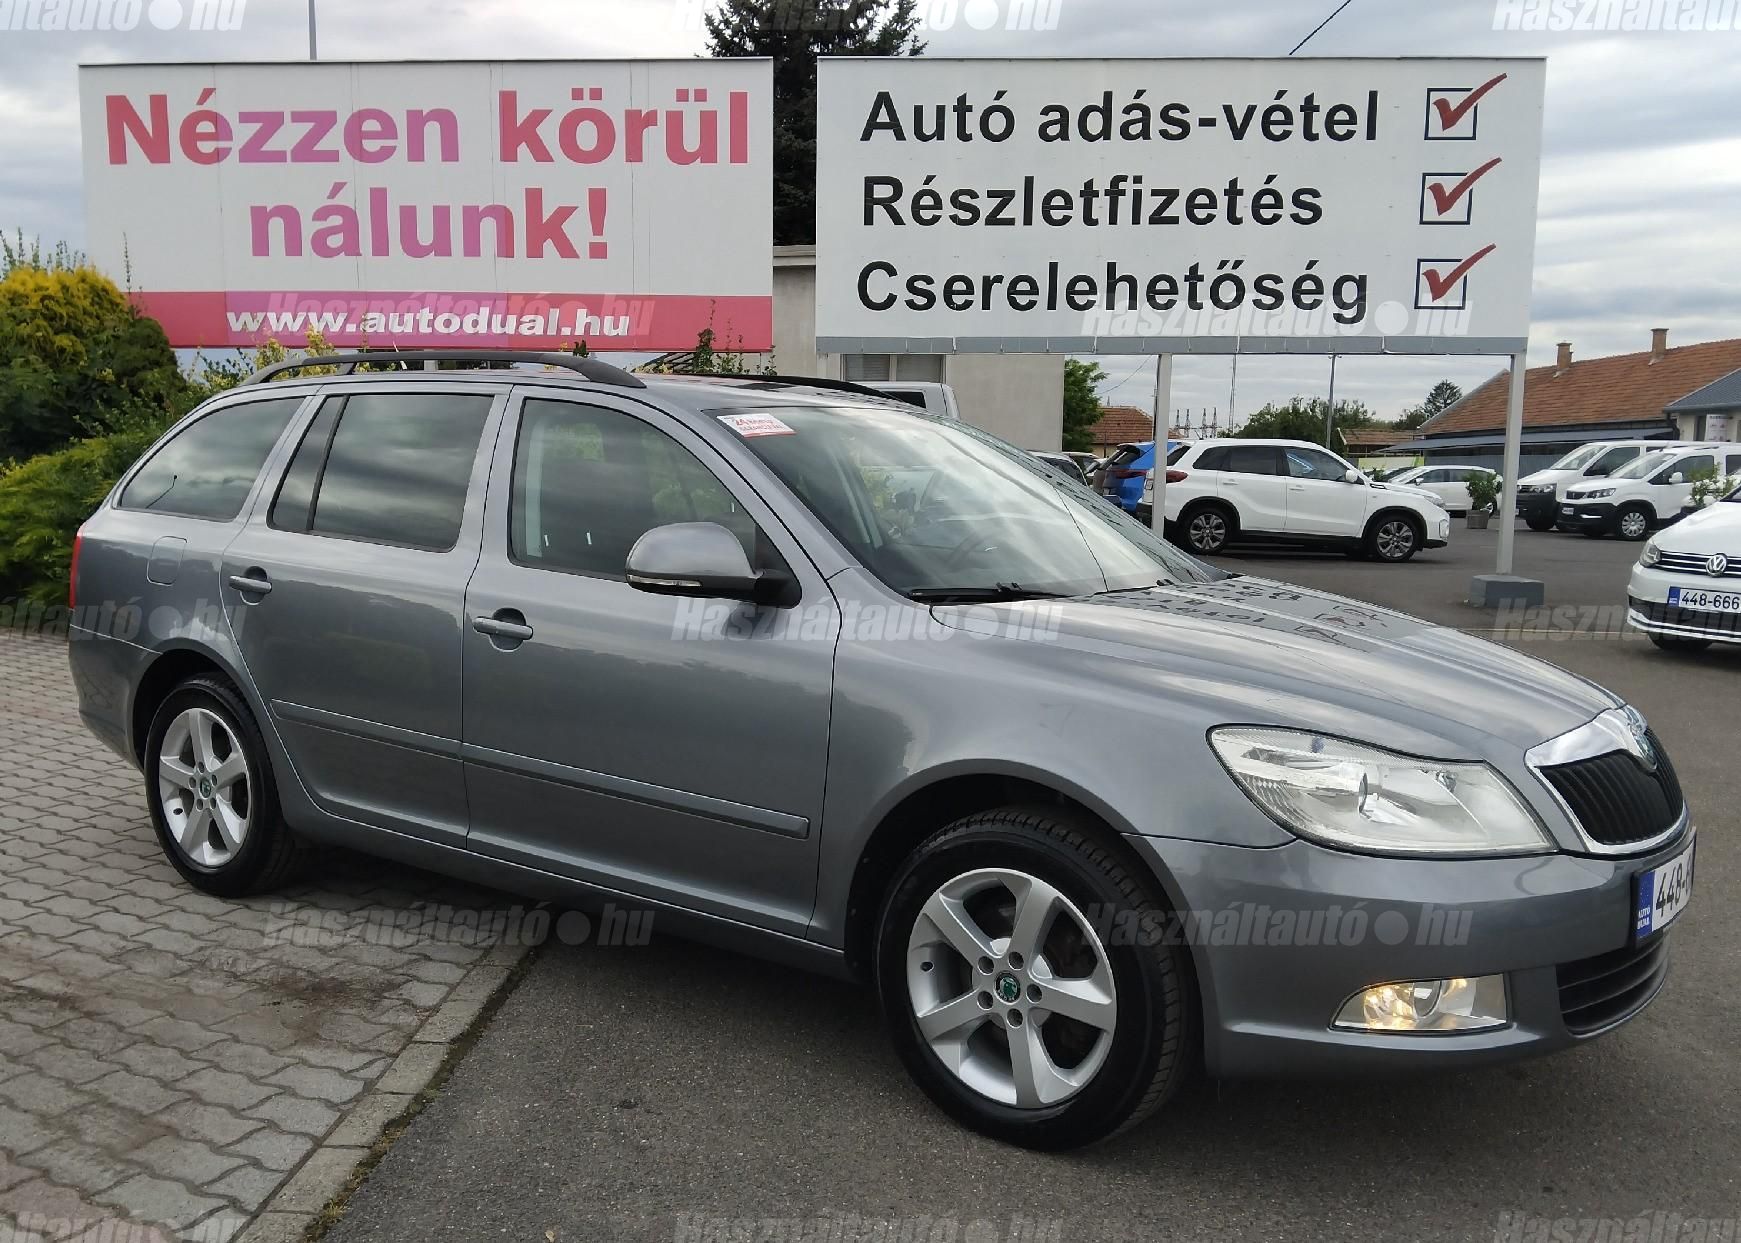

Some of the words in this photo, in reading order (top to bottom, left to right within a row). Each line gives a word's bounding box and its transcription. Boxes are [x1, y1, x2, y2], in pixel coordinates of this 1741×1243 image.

[106, 88, 459, 165] Nézzen
[499, 88, 748, 165] körül
[860, 90, 1015, 143] Autó
[1038, 89, 1378, 143] adás-vétel
[251, 183, 608, 259] nálunk!
[863, 175, 1323, 227] Részletfizetés
[857, 259, 1367, 325] Cserelehetőség
[227, 307, 630, 337] www.autodual.hu
[1681, 591, 1740, 610] 448-666
